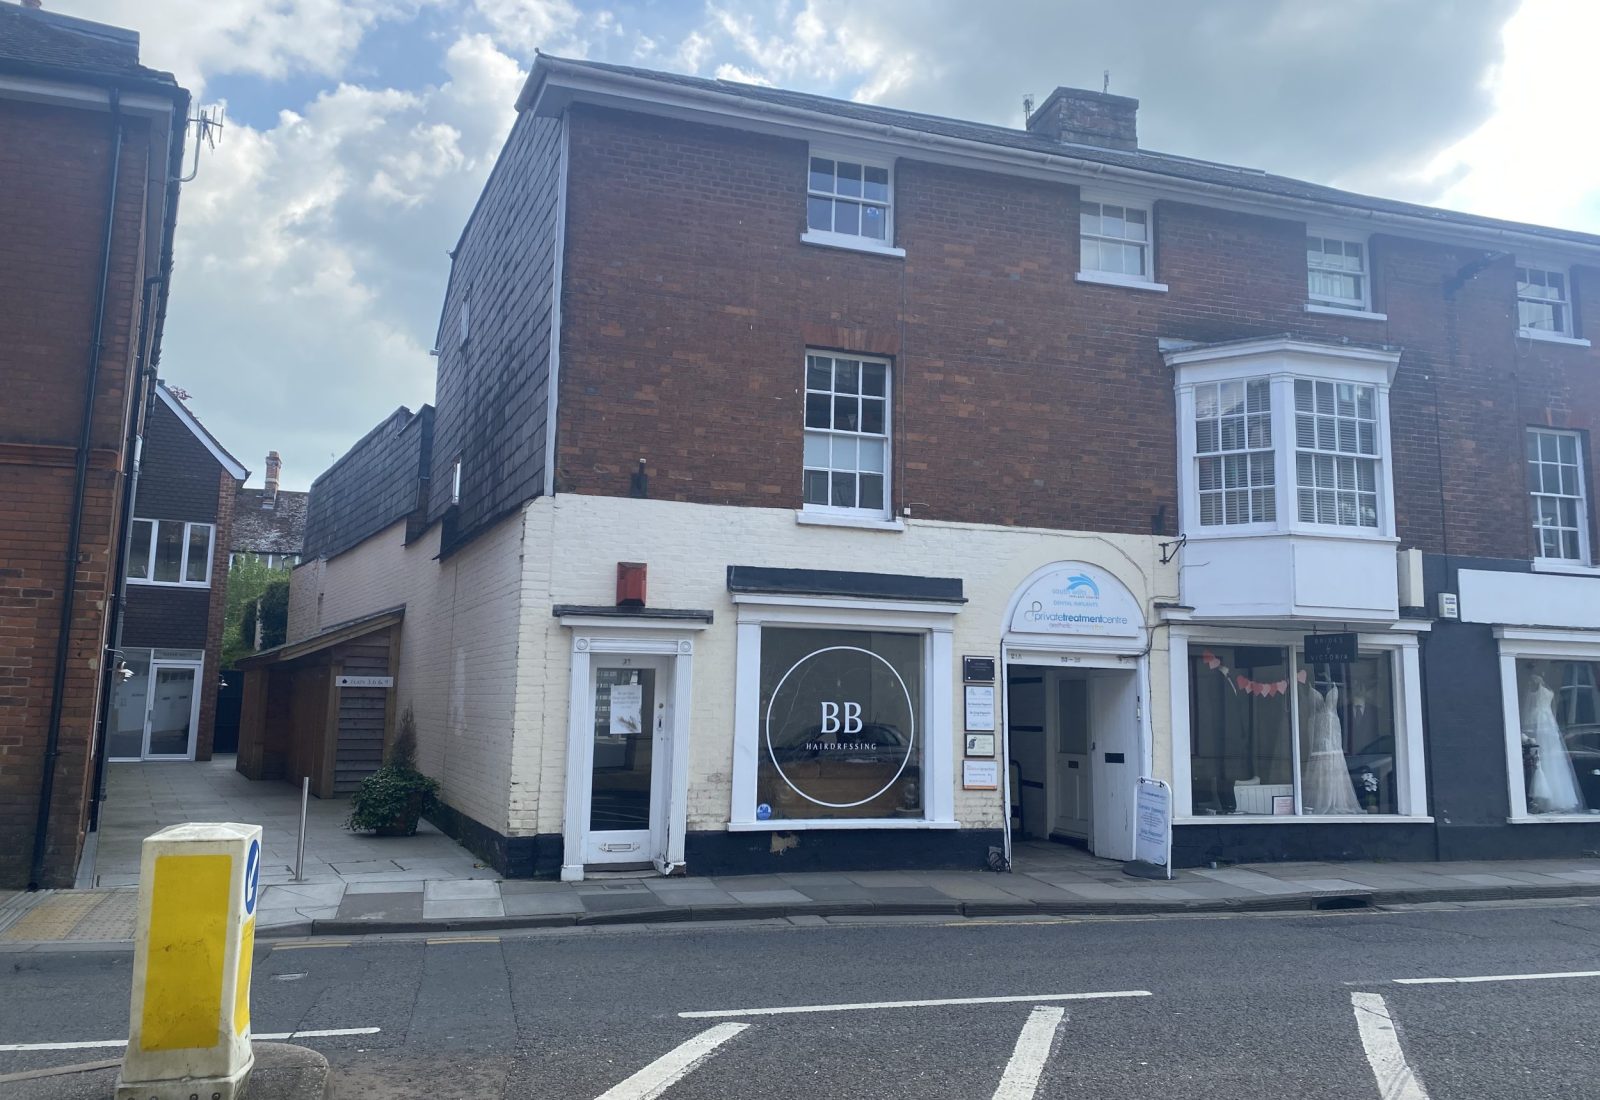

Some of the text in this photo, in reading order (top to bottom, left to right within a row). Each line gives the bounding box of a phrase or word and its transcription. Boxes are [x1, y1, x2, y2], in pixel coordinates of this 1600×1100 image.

[1034, 612, 1128, 625] privatetreatmentcentre
[821, 701, 863, 734] BB
[806, 742, 877, 751] HAIRDRESSING
